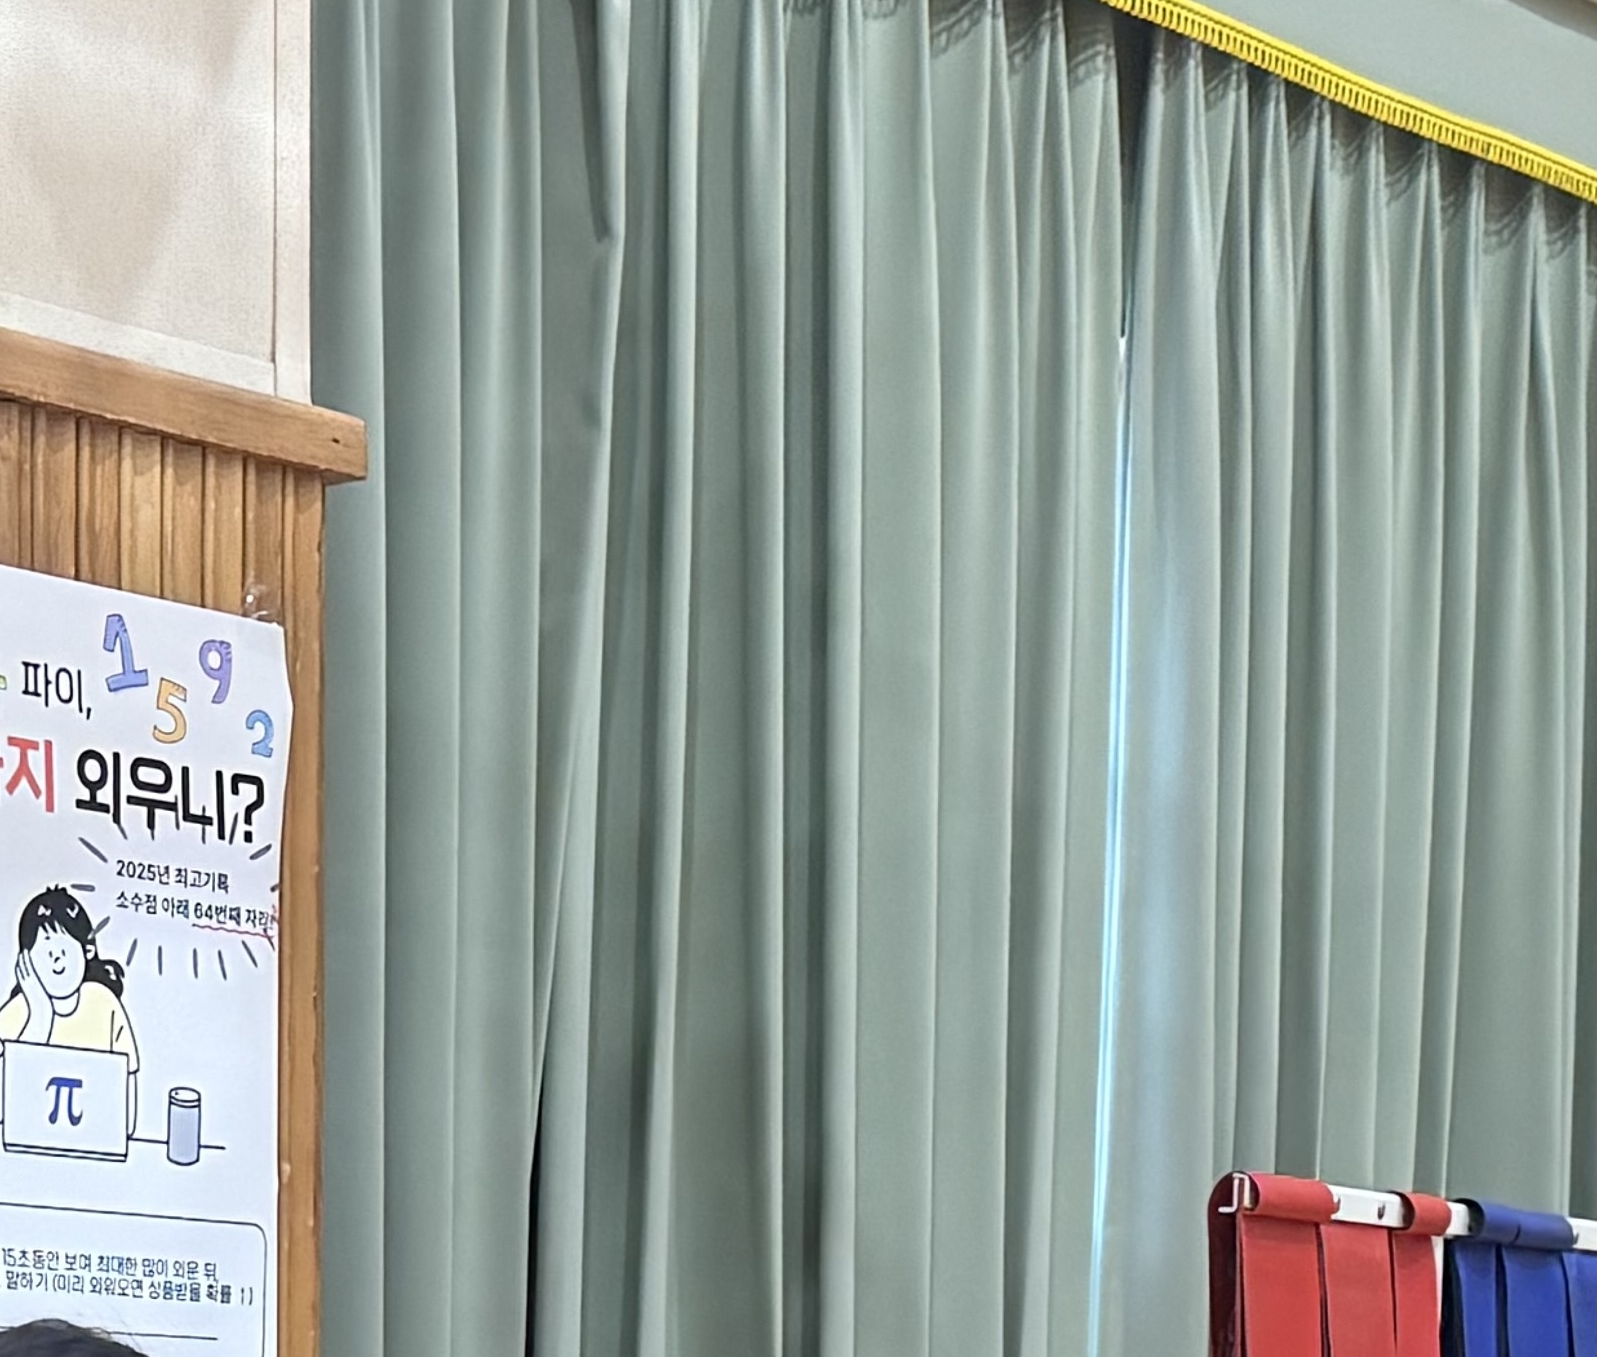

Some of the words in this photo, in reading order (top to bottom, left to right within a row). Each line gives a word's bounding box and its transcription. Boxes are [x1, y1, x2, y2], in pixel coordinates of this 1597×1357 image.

[21, 660, 93, 719] 파이,
[103, 614, 148, 692] 1
[152, 678, 187, 743] 5
[199, 640, 232, 704] 9
[246, 710, 273, 757] 2
[75, 748, 266, 843] 외우니?
[116, 860, 170, 885] 2025년
[174, 867, 229, 894] 최고기록
[116, 891, 157, 915] 소수점
[162, 897, 189, 919] 아래
[194, 902, 241, 926] 64번째
[1, 1248, 60, 1271] 15초동안
[97, 1255, 138, 1277] 최대한
[141, 1258, 168, 1278] 많이
[173, 1260, 199, 1280] 외운
[52, 1273, 84, 1294] (미리
